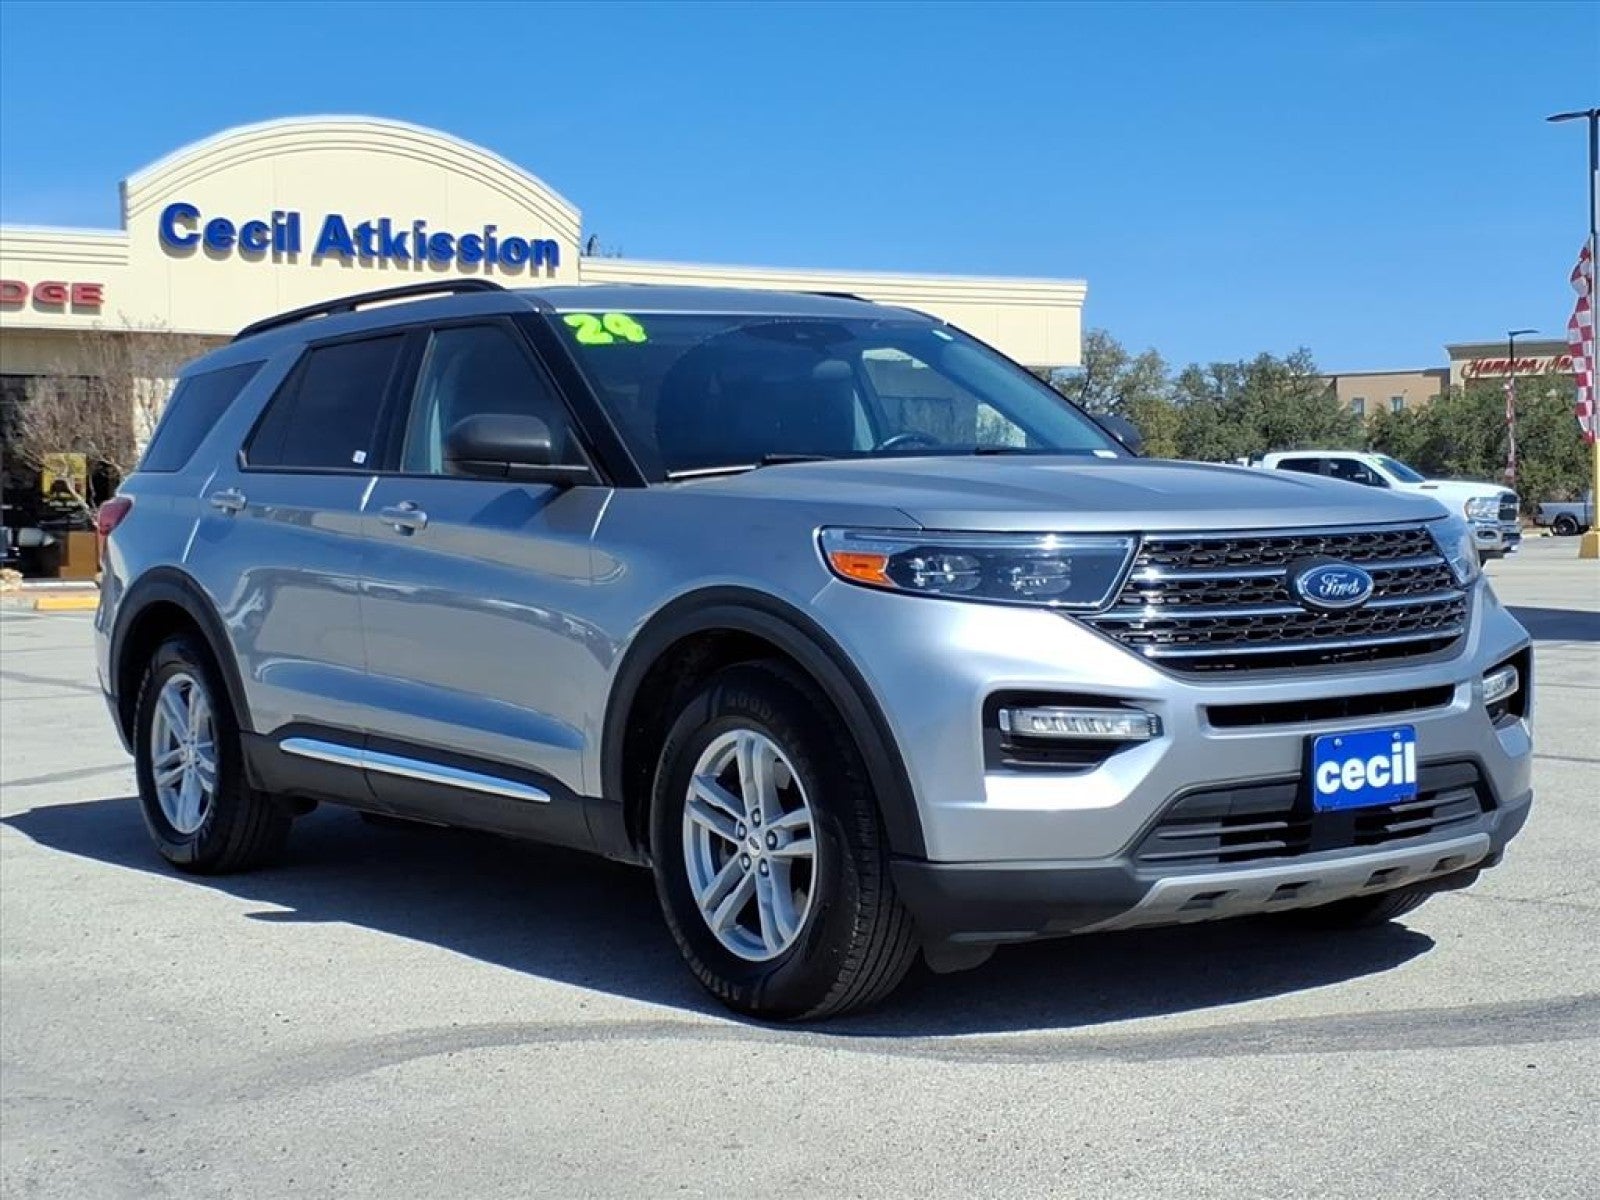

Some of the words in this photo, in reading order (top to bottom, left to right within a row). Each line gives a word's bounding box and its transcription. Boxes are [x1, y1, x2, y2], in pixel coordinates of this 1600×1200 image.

[160, 203, 301, 254] Cecil
[315, 213, 561, 269] Atkission
[1319, 573, 1360, 596] Ford
[1316, 741, 1416, 795] cecil
